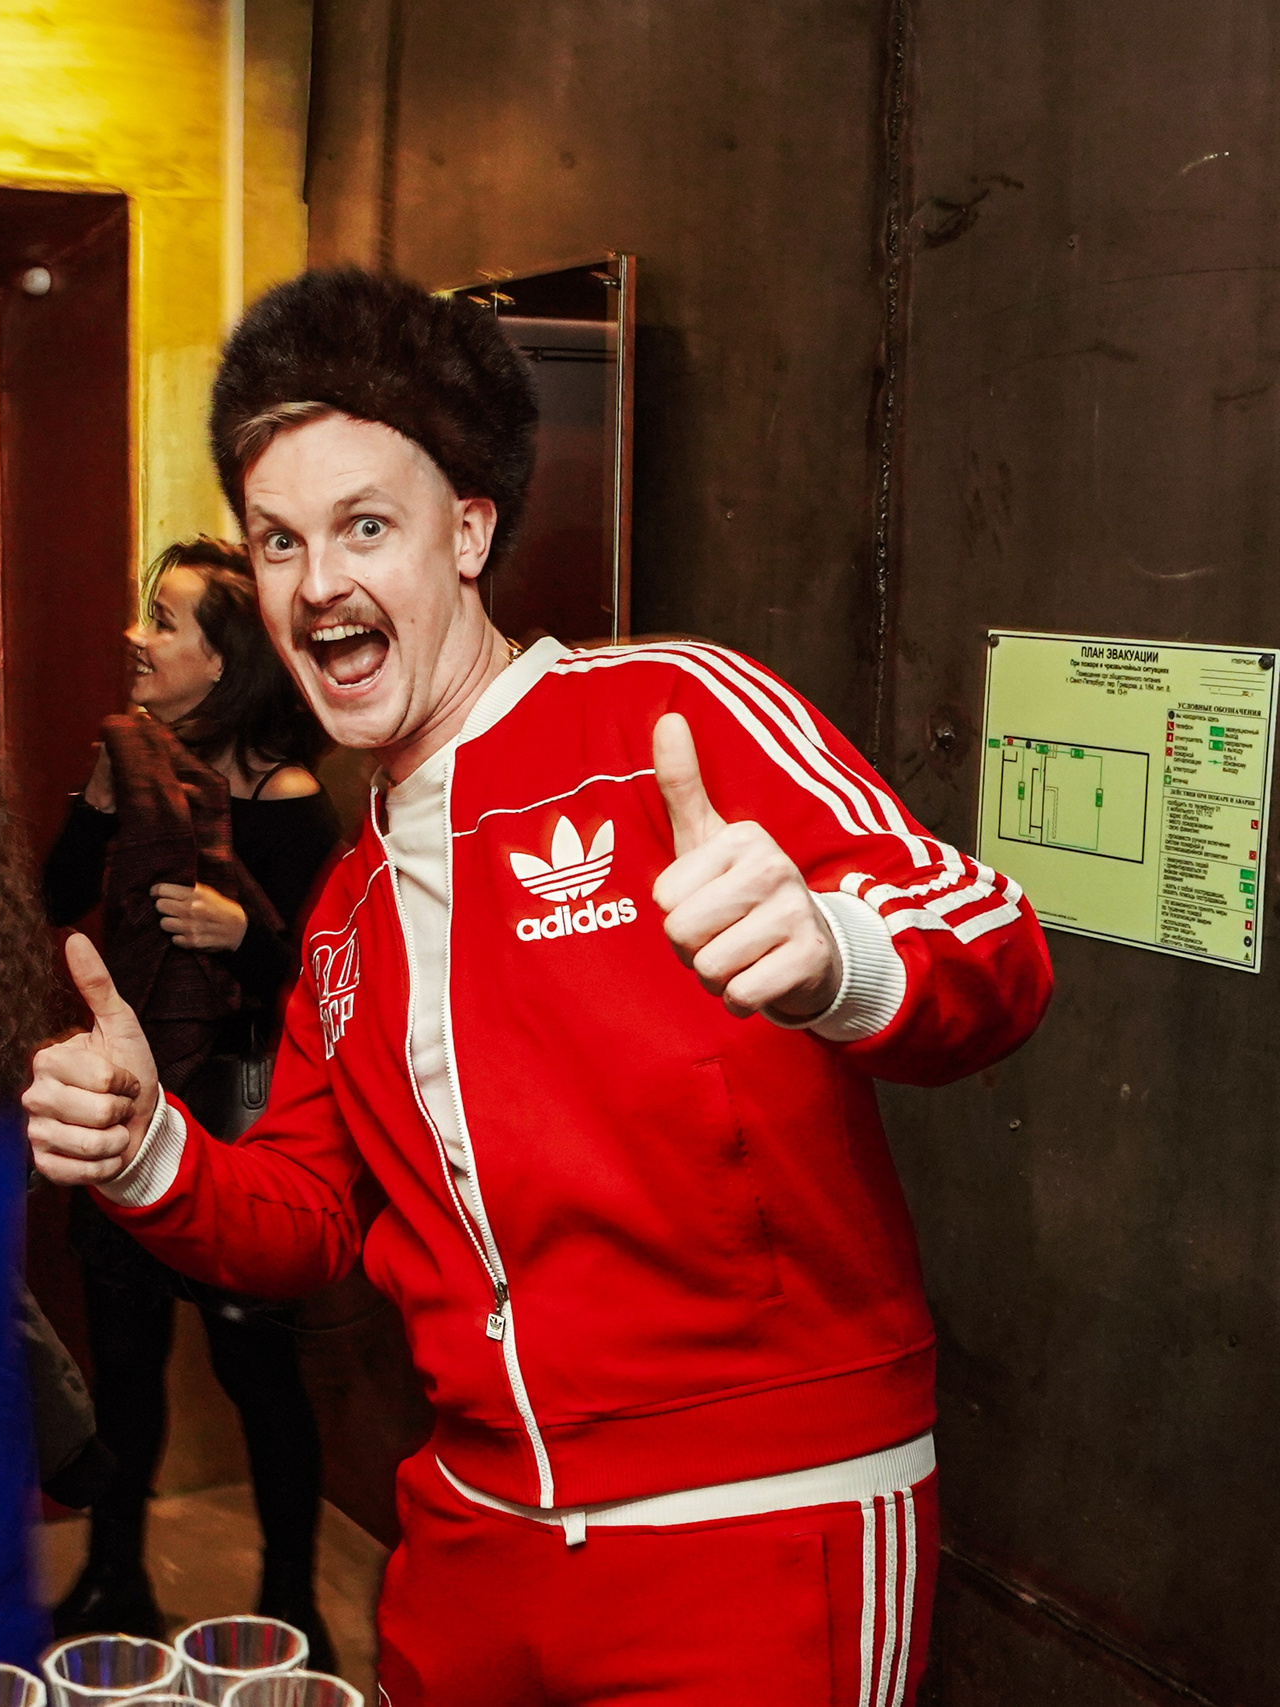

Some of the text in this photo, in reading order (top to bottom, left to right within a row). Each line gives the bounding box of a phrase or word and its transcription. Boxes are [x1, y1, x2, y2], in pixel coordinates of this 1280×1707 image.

[1081, 646, 1159, 664] ПЛАН ЭВАКУАЦИИ
[1178, 702, 1262, 716] УСЛОВНЫЕ ОБОЗНАЧЕНИЯ
[516, 898, 637, 941] adidas
